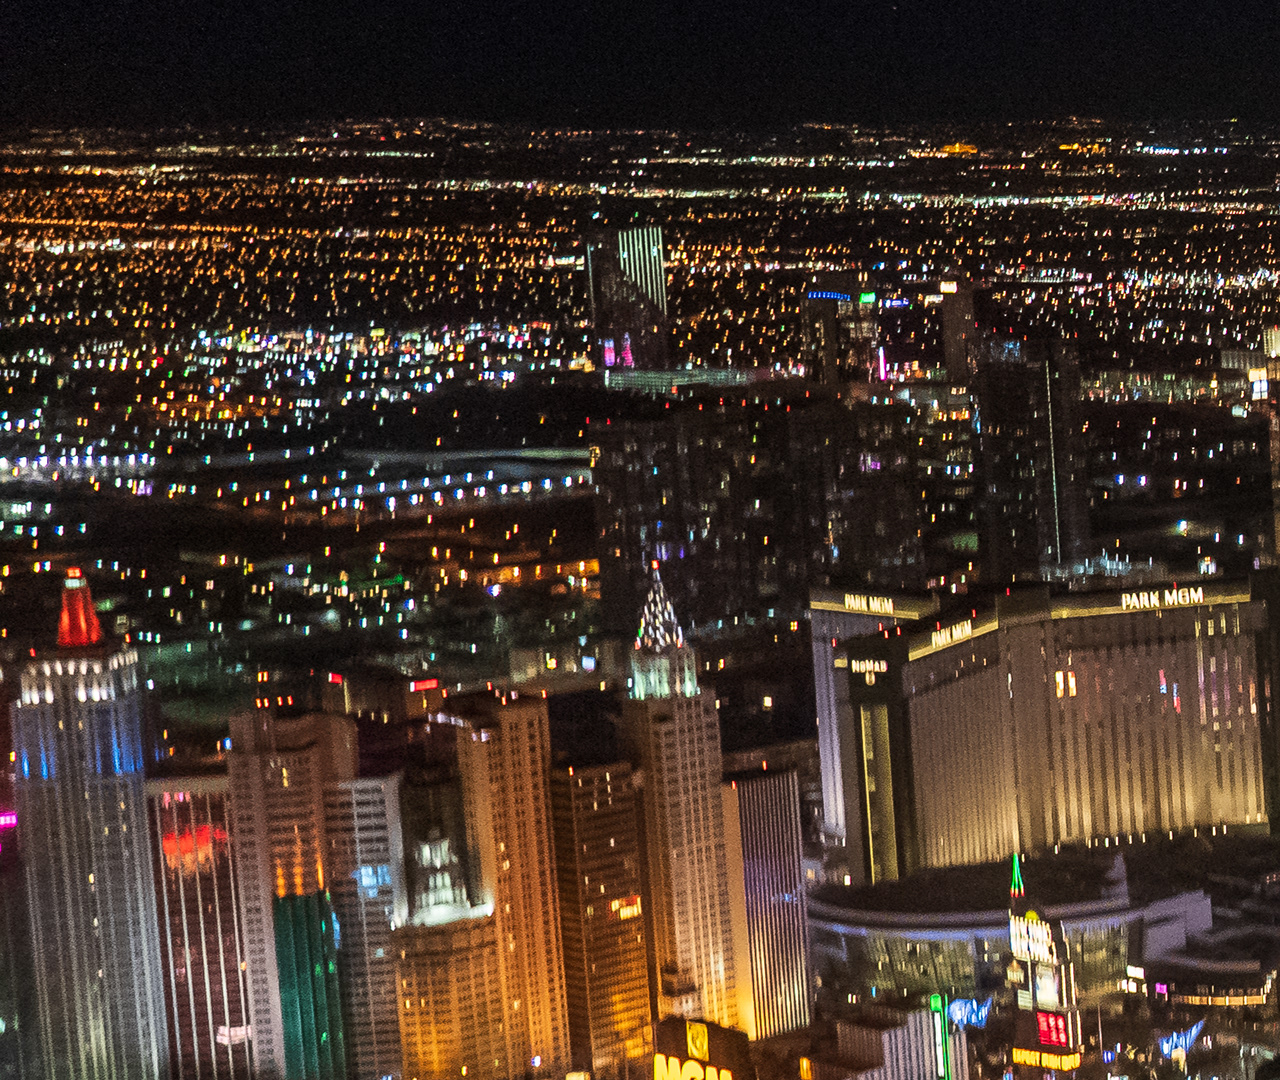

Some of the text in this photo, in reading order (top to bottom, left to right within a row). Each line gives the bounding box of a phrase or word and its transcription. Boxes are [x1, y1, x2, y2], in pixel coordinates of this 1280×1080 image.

[844, 594, 894, 614] PARK MGM
[1121, 587, 1204, 611] PARK MGM
[931, 619, 972, 649] PARK MGM
